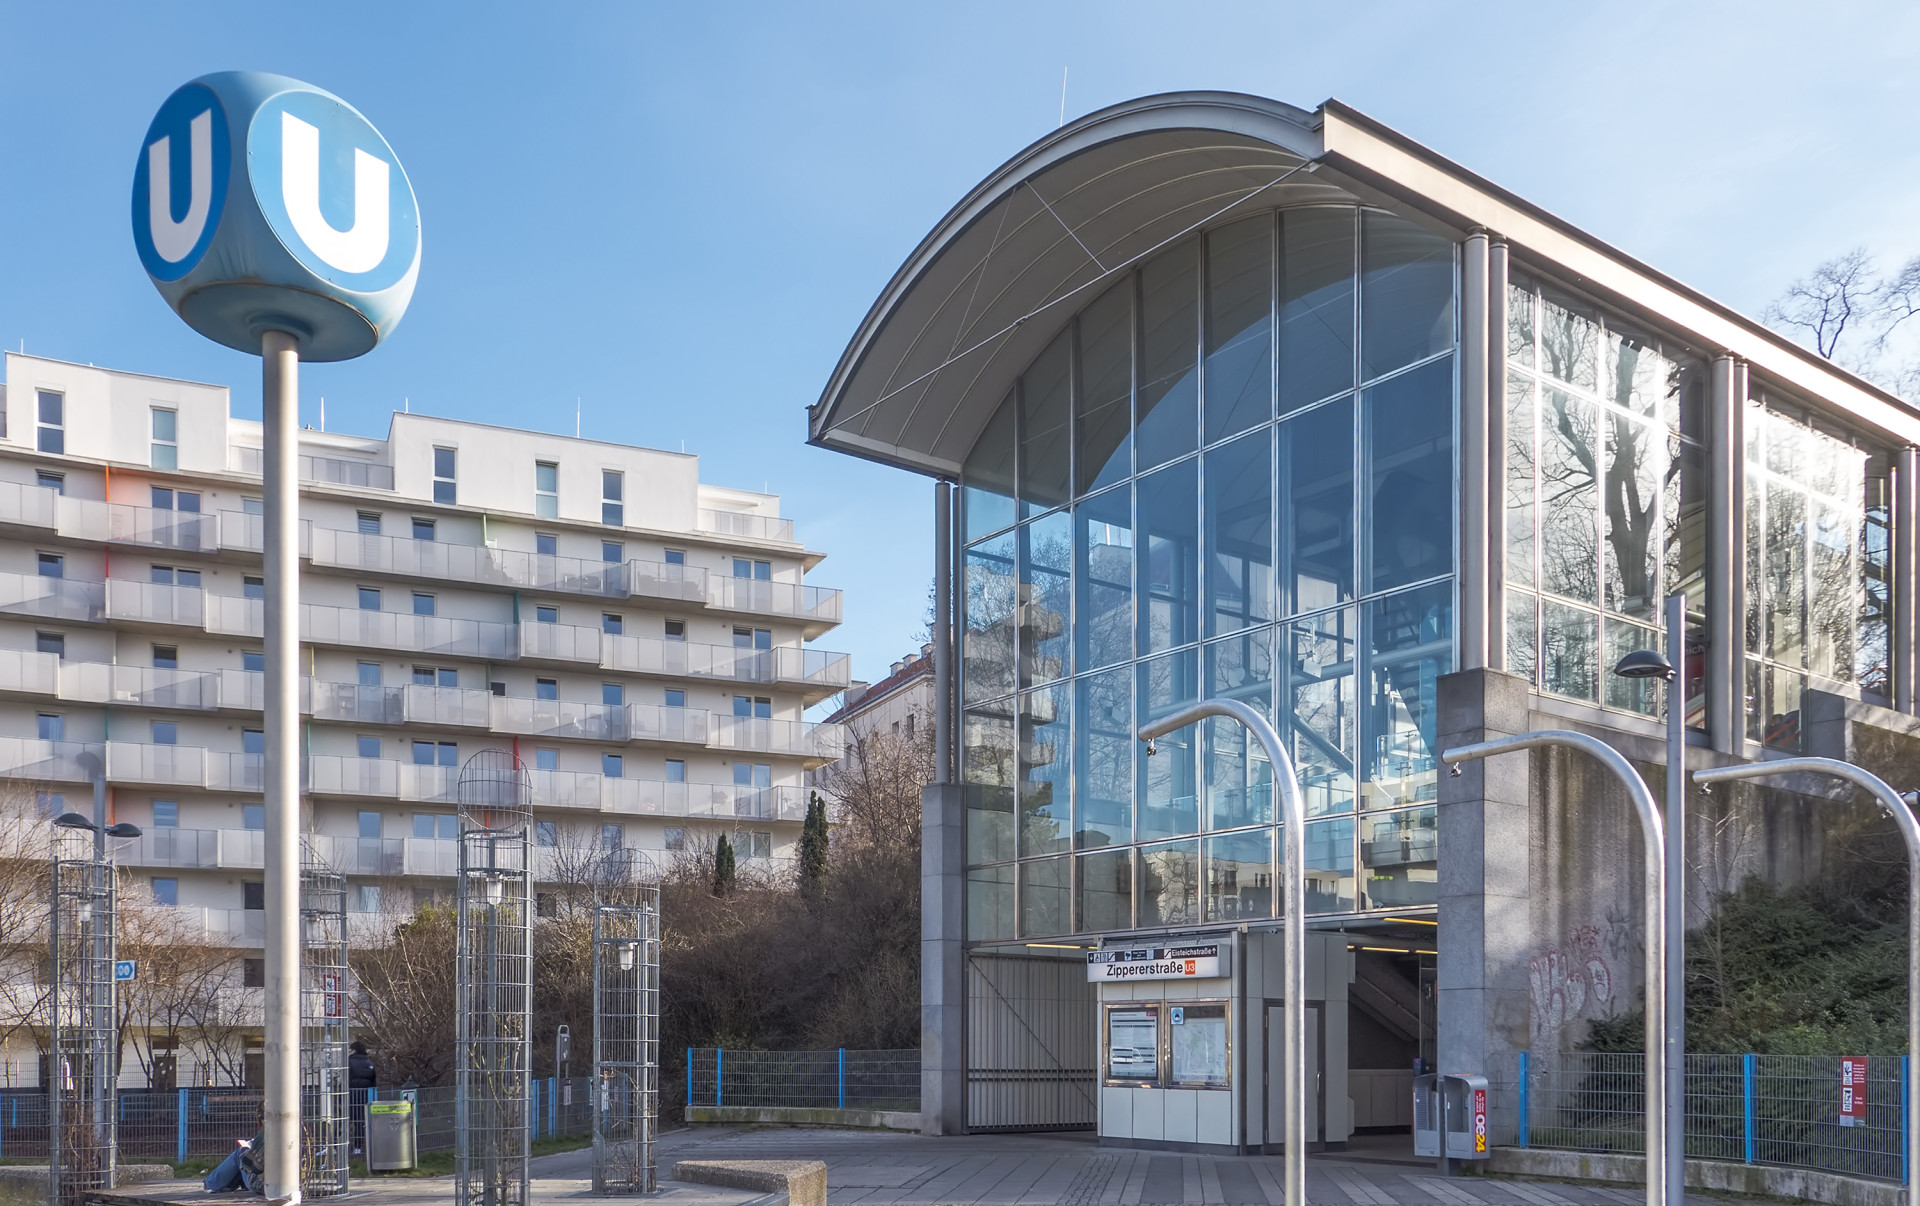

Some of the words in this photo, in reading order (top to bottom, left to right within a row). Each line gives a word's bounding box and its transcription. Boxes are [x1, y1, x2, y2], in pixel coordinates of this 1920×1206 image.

[149, 108, 212, 263] U
[282, 111, 389, 273] U
[1106, 961, 1183, 978] Zippererstraße
[1185, 963, 1195, 972] U3
[1171, 948, 1211, 957] Eisteichstraße
